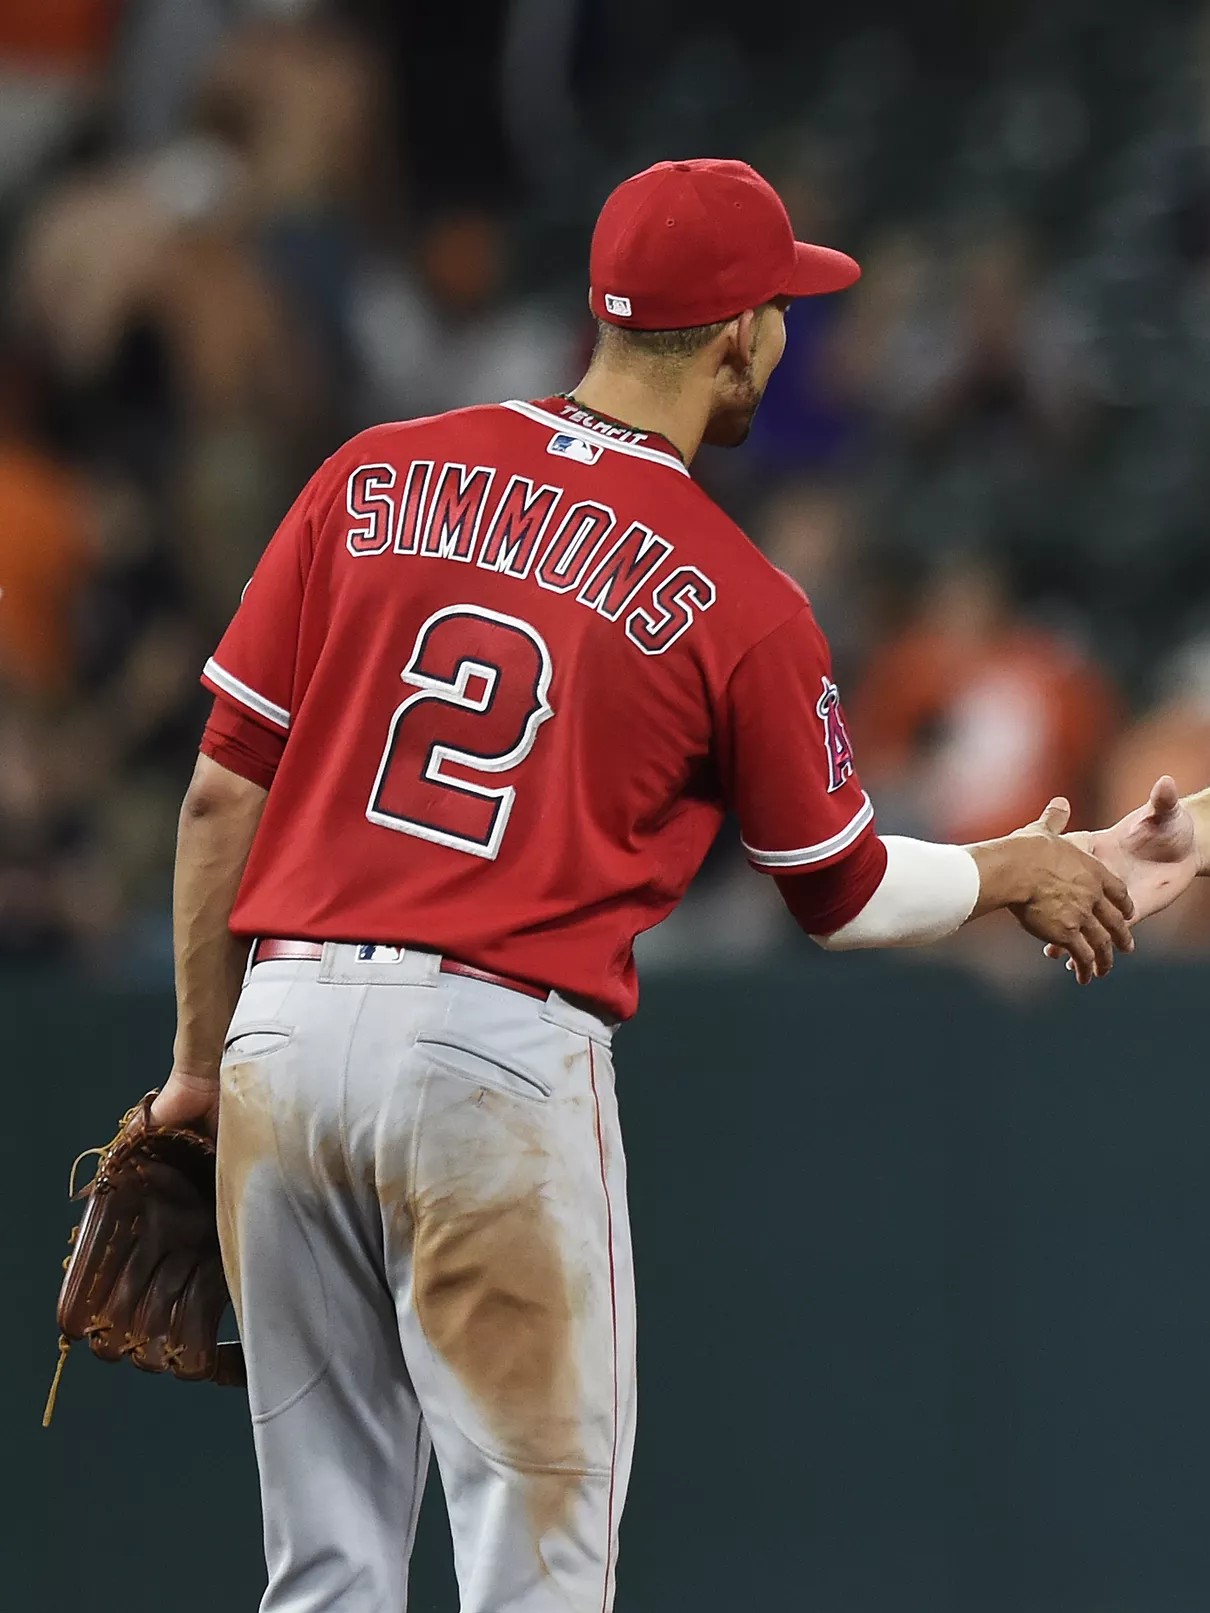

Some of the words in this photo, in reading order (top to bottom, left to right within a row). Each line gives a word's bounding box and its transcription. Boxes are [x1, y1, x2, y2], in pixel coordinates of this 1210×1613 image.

[346, 460, 716, 656] SIMMONS
[365, 603, 555, 861] 2
[816, 675, 853, 794] A
